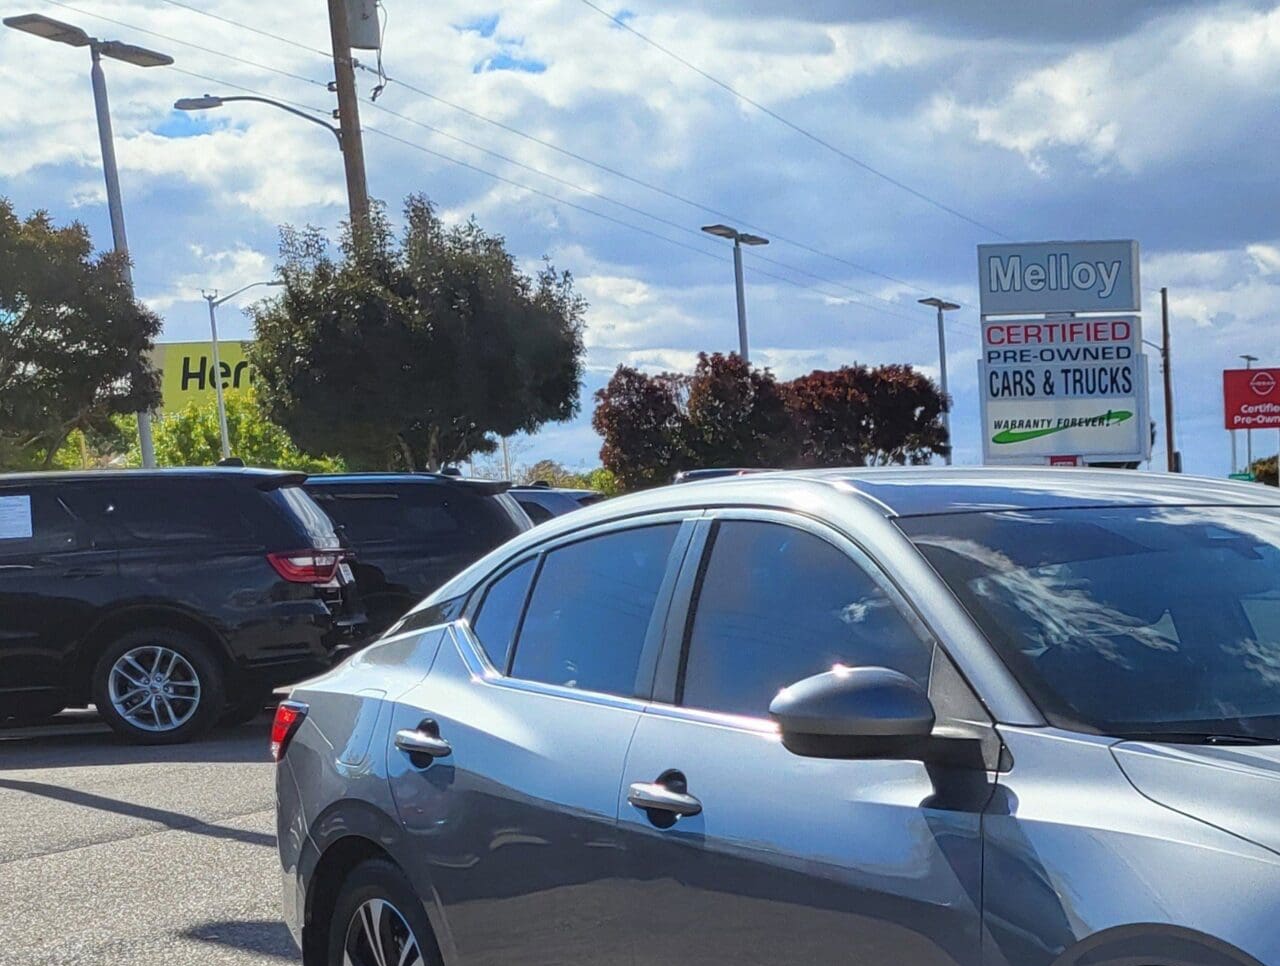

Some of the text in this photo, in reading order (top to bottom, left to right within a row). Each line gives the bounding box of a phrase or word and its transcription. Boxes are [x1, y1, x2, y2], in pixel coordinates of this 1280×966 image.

[988, 253, 1121, 298] Melloy
[986, 321, 1131, 345] CERTIFIED
[987, 346, 1132, 364] PRE-OWNED
[181, 356, 255, 391] Her
[989, 366, 1132, 398] CARS & TRUCKS
[994, 418, 1053, 430] WARRANTY
